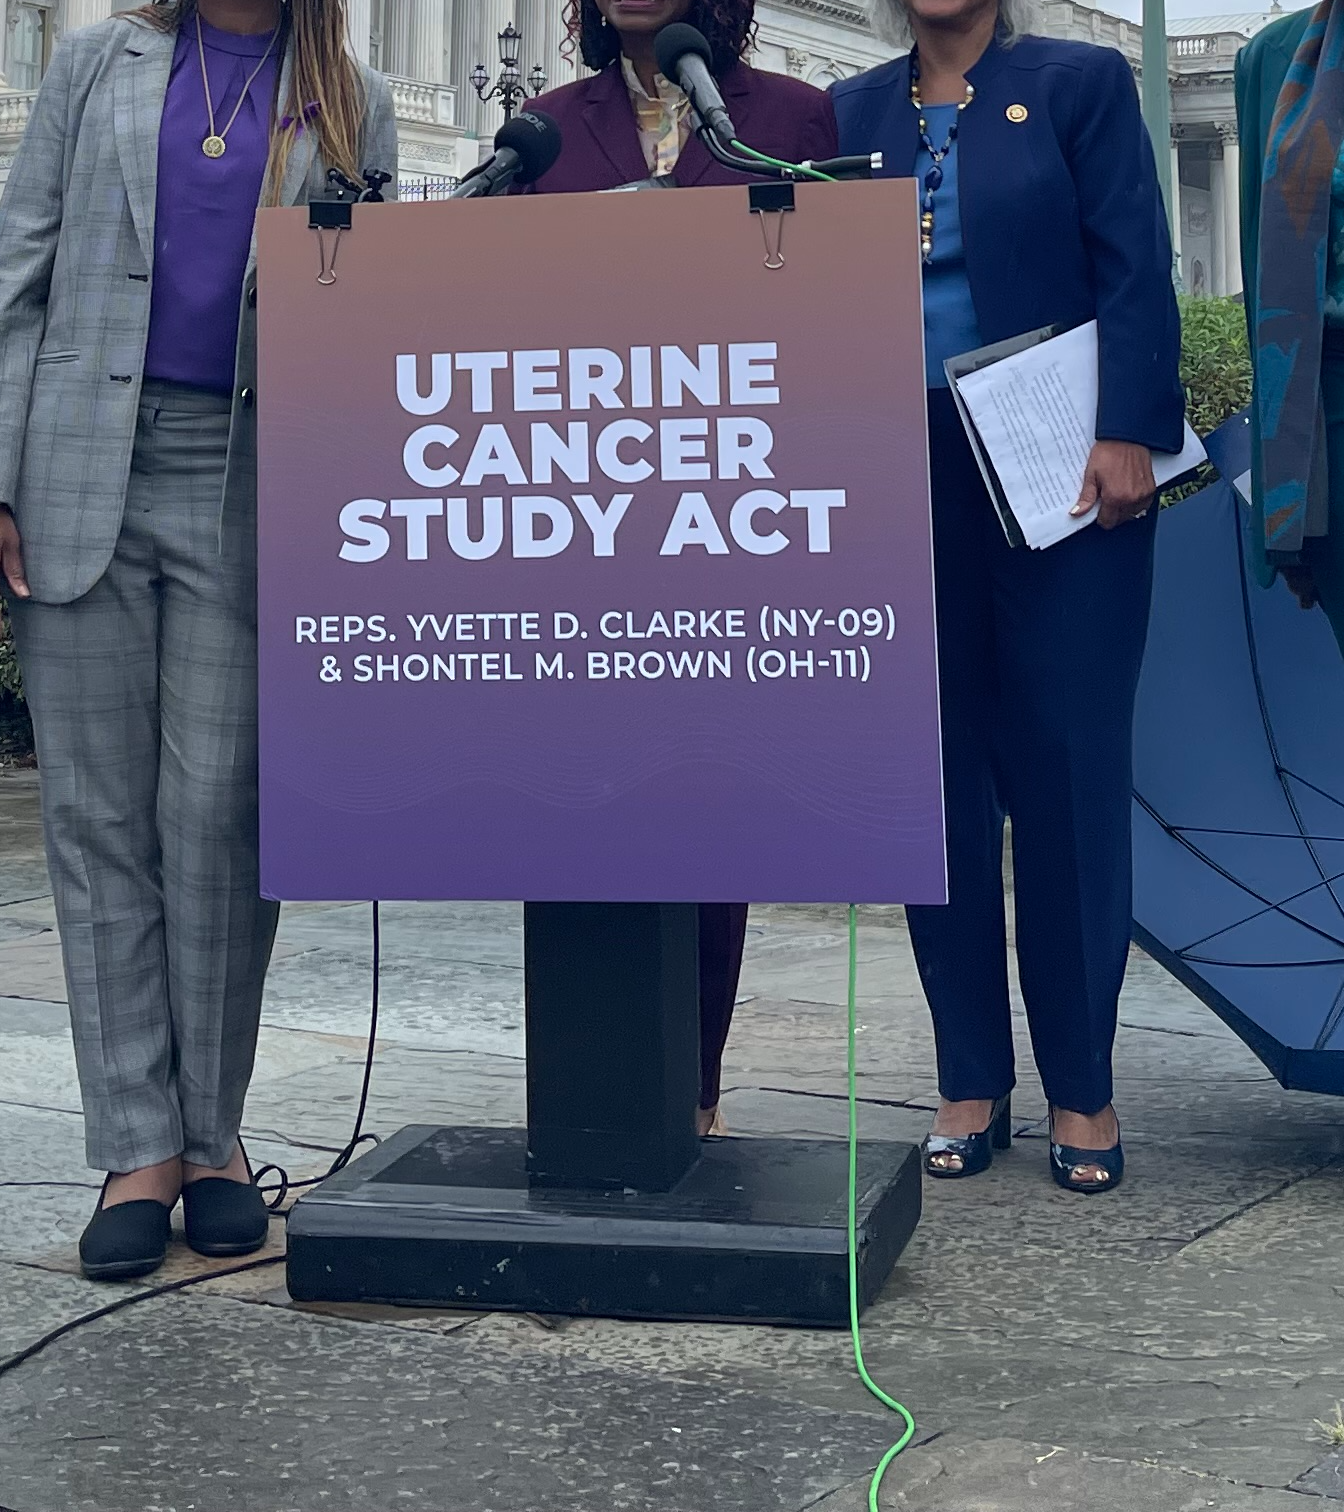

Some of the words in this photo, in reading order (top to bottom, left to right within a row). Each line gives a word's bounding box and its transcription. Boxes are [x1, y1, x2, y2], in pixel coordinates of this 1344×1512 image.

[395, 341, 781, 416] UTERINE
[402, 417, 776, 488] CANCER
[337, 492, 635, 563] STUDY
[658, 488, 847, 556] ACT
[294, 614, 397, 644] REPS.
[405, 611, 542, 642] YVETTE
[553, 611, 589, 641] D.
[598, 608, 747, 640] CLARKE
[759, 603, 897, 643] (NY-09)
[318, 654, 343, 683] &
[352, 652, 524, 683] SHONTEL
[534, 651, 575, 681] M.
[586, 649, 732, 680] BROWN
[745, 644, 872, 683] (OH-11)
